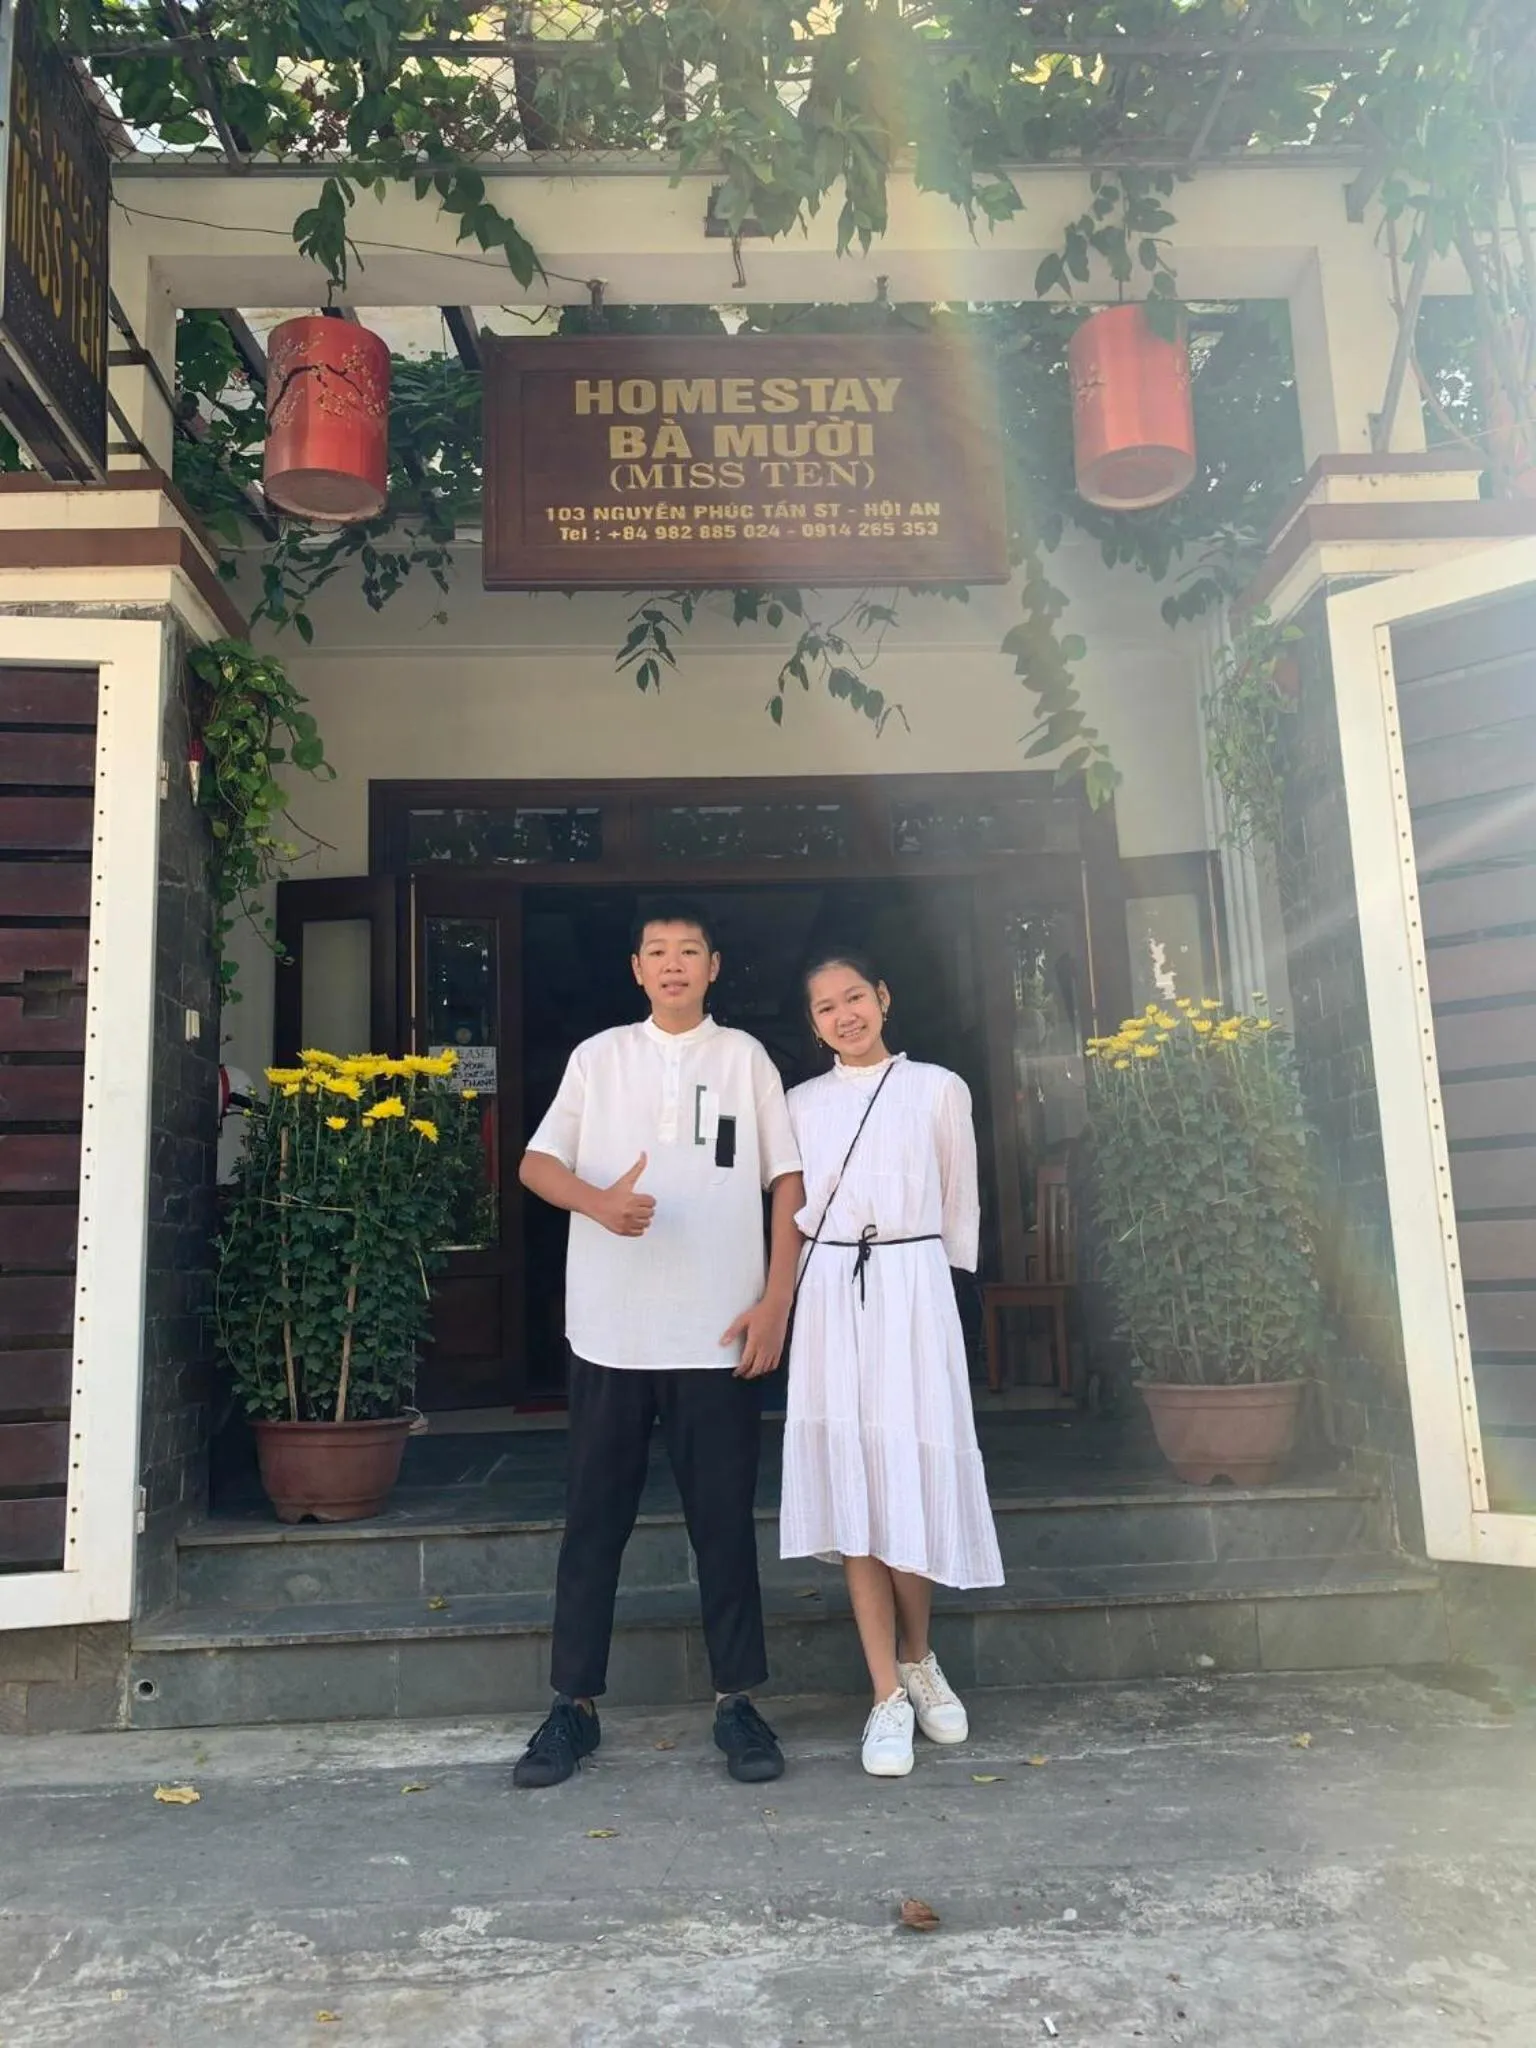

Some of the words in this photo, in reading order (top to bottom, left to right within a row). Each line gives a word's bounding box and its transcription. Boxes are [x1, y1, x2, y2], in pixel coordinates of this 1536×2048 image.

[11, 132, 64, 319] MISS
[574, 378, 902, 415] HOMESTAY
[609, 415, 692, 460] BÀ
[713, 417, 874, 458] MƯỜI
[610, 462, 745, 493] (MISS
[760, 461, 876, 489] TEN)
[545, 507, 586, 522] 103
[693, 503, 754, 520] PHÚC
[813, 503, 841, 518] ST
[864, 500, 901, 521] HỘI
[908, 502, 941, 518] AN
[559, 527, 588, 541] Tel
[607, 525, 648, 541] +84
[743, 523, 781, 539] 024
[801, 523, 852, 538] 0914
[858, 522, 896, 537] 265
[902, 521, 940, 536] 353
